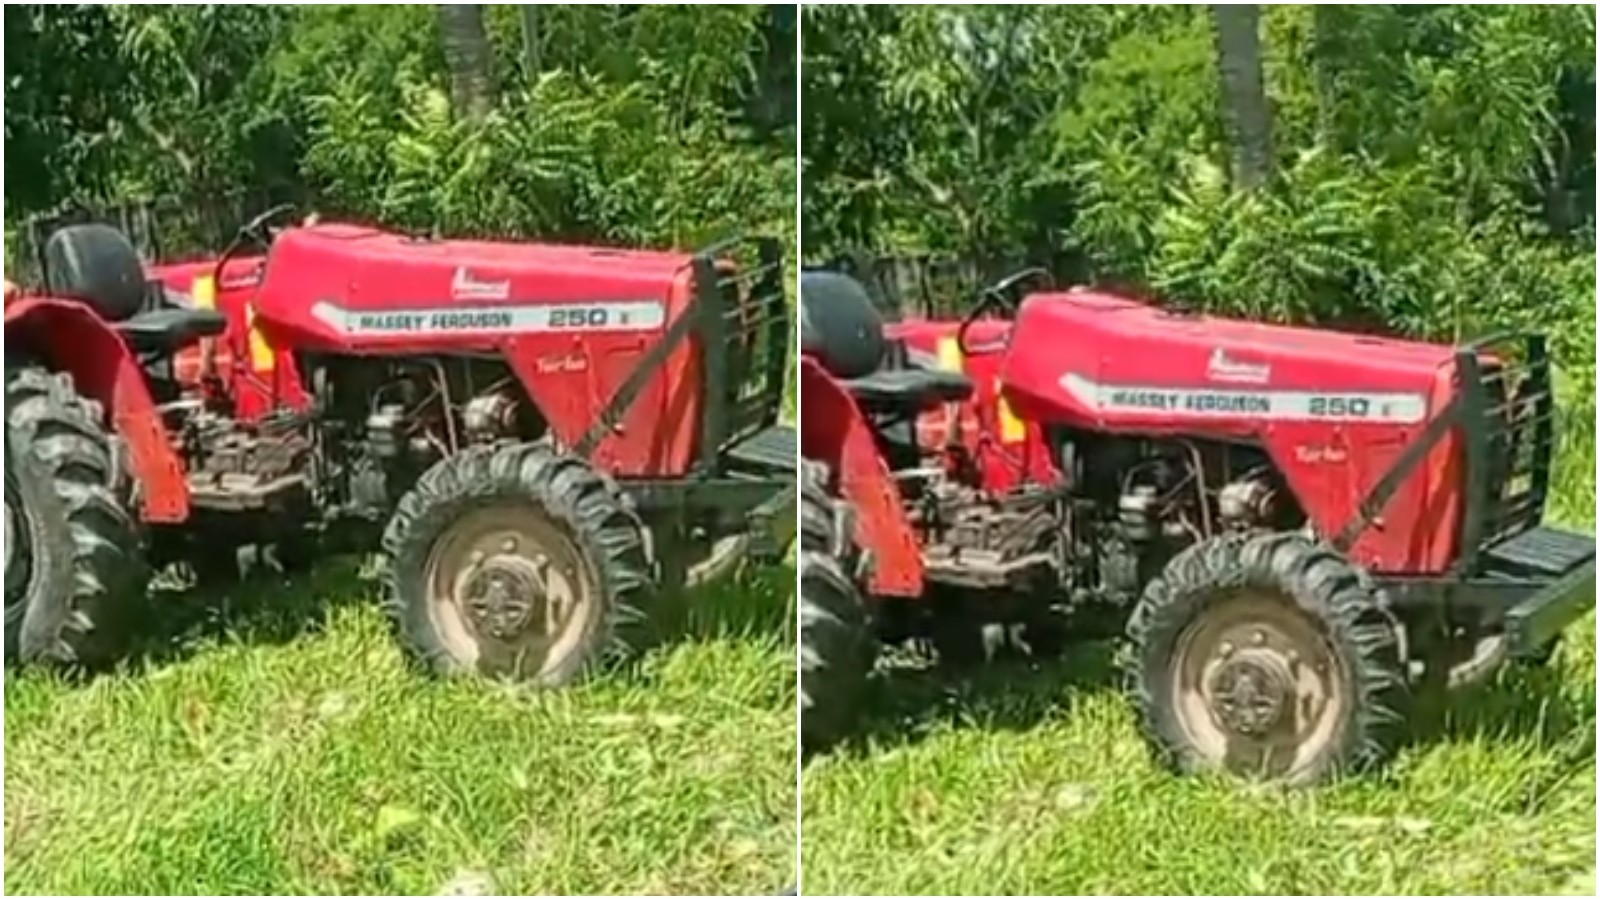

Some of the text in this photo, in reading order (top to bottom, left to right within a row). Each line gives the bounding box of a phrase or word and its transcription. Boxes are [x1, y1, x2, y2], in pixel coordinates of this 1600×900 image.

[360, 315, 424, 330] MASSEY
[430, 312, 513, 329] FERGUSON
[549, 308, 608, 327] 250
[1112, 391, 1179, 410] MASSEY
[1309, 397, 1369, 416] 250
